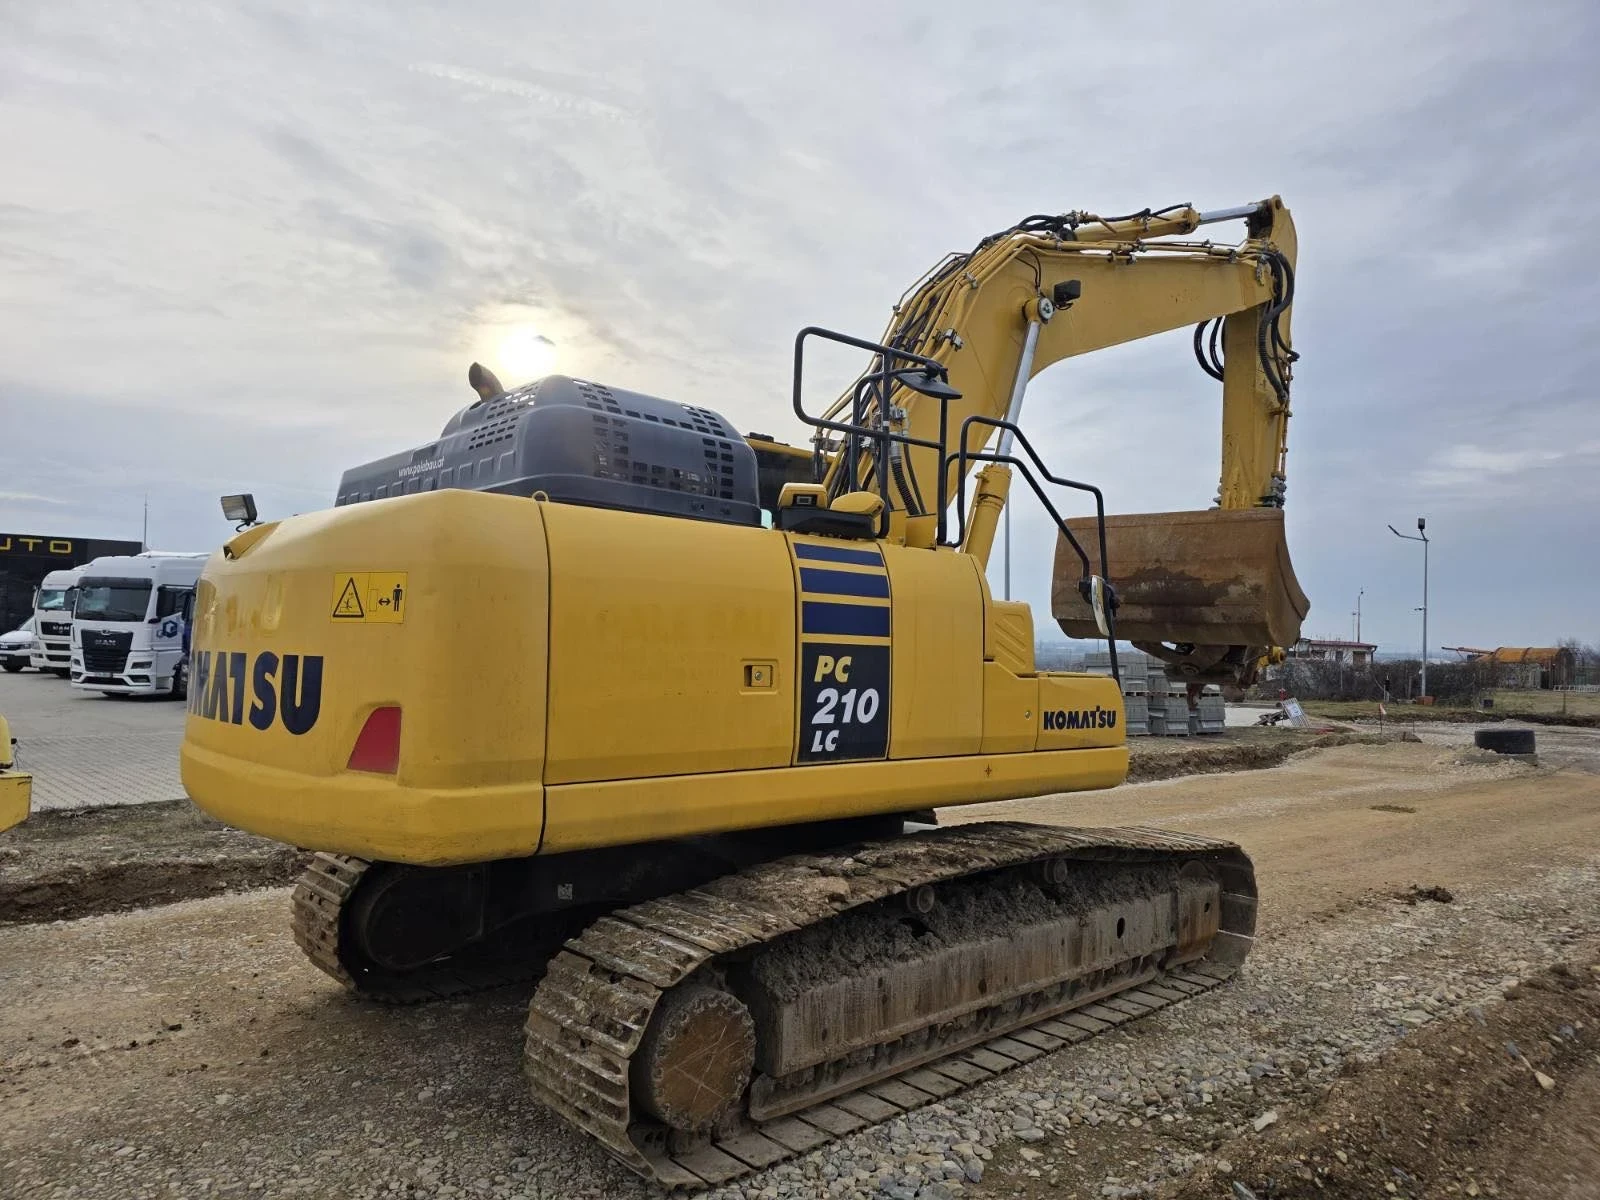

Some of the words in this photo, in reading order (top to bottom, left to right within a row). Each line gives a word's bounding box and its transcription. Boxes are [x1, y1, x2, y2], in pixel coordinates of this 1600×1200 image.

[814, 655, 852, 683] PC
[811, 688, 879, 725] 210
[1043, 705, 1117, 730] KOMATSU
[811, 730, 840, 752] LC
